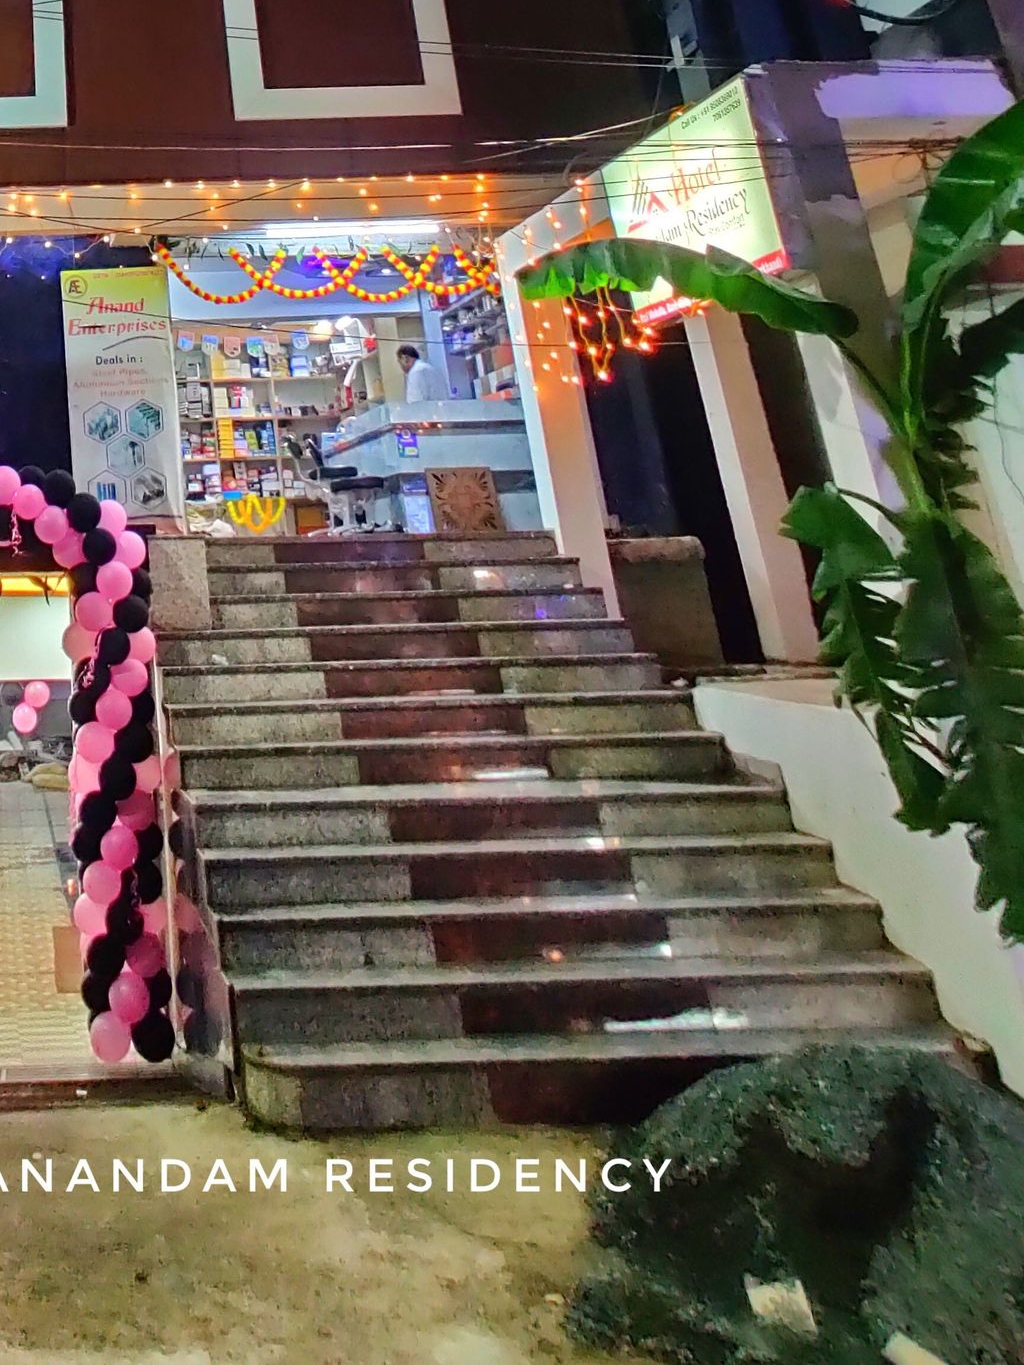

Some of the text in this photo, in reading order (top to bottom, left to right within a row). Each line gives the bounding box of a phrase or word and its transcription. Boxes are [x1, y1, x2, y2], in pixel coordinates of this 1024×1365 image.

[670, 146, 721, 205] Hotel
[686, 188, 750, 237] Residency
[86, 296, 145, 315] Anand
[67, 318, 167, 337] Enterprises
[95, 355, 124, 366] Deals
[127, 353, 136, 363] in
